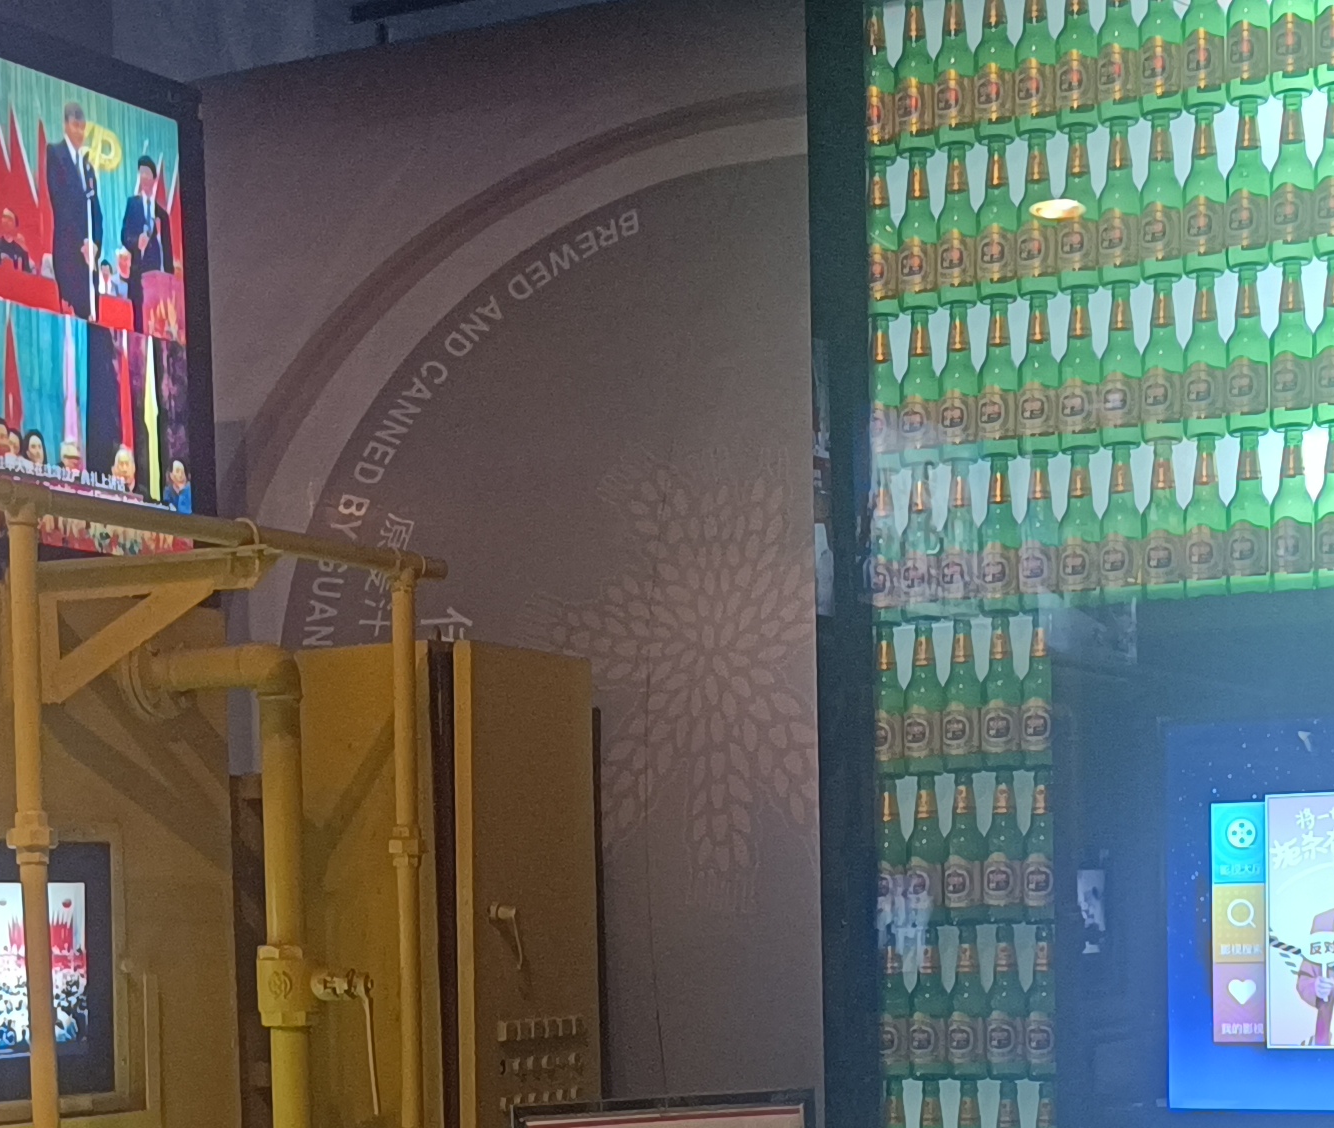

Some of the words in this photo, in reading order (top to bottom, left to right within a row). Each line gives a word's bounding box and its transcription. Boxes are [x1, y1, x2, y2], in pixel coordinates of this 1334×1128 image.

[507, 208, 641, 301] BREWED
[443, 294, 505, 358] AND
[353, 360, 449, 485] CANNED
[330, 494, 371, 541] BY
